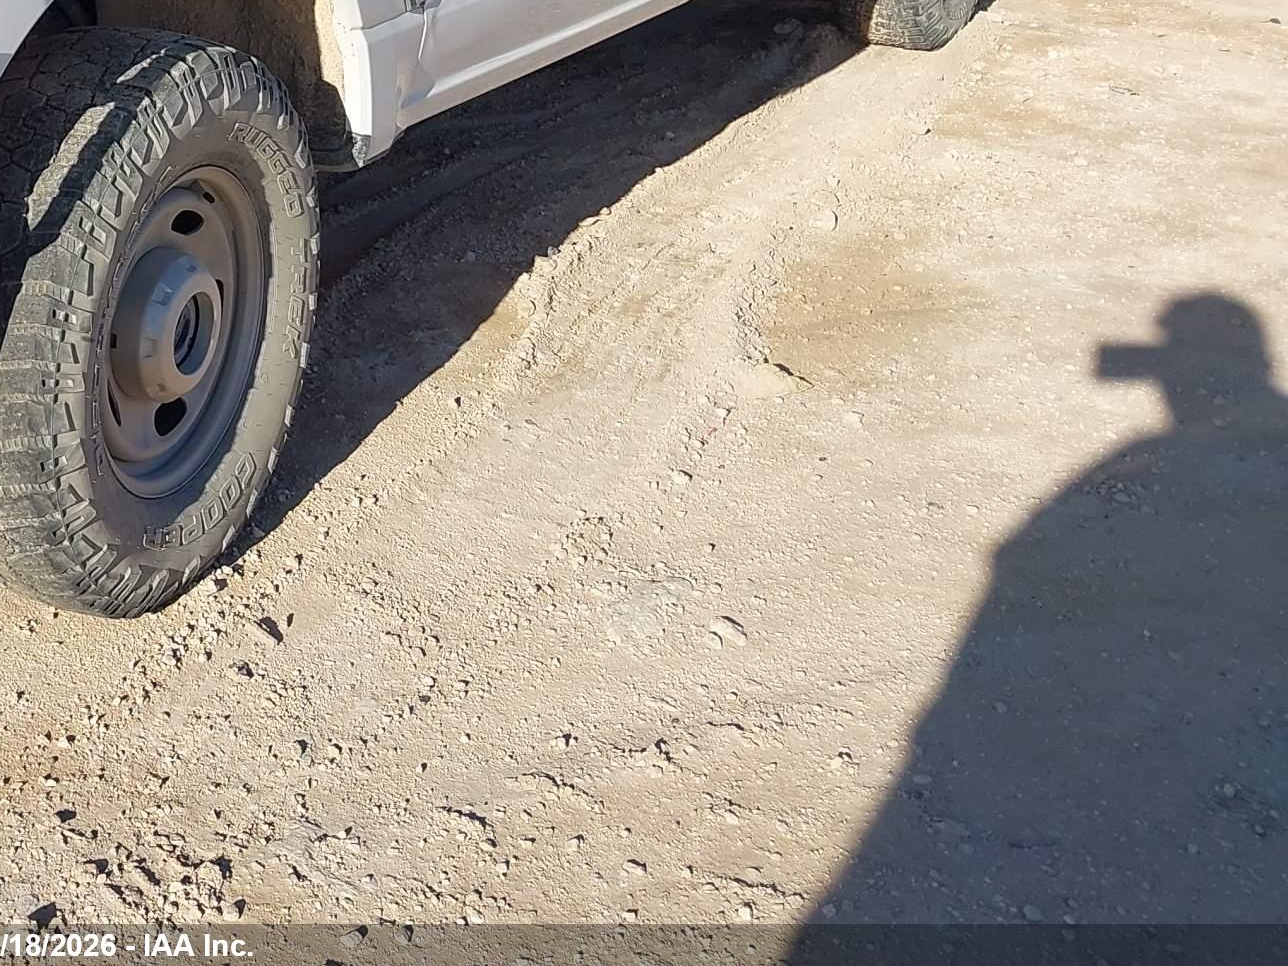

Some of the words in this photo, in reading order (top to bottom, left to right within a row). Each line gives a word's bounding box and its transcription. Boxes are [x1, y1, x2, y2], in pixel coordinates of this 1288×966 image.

[227, 122, 305, 218] RUGGED
[282, 238, 308, 359] TREK
[140, 451, 256, 552] COOPER
